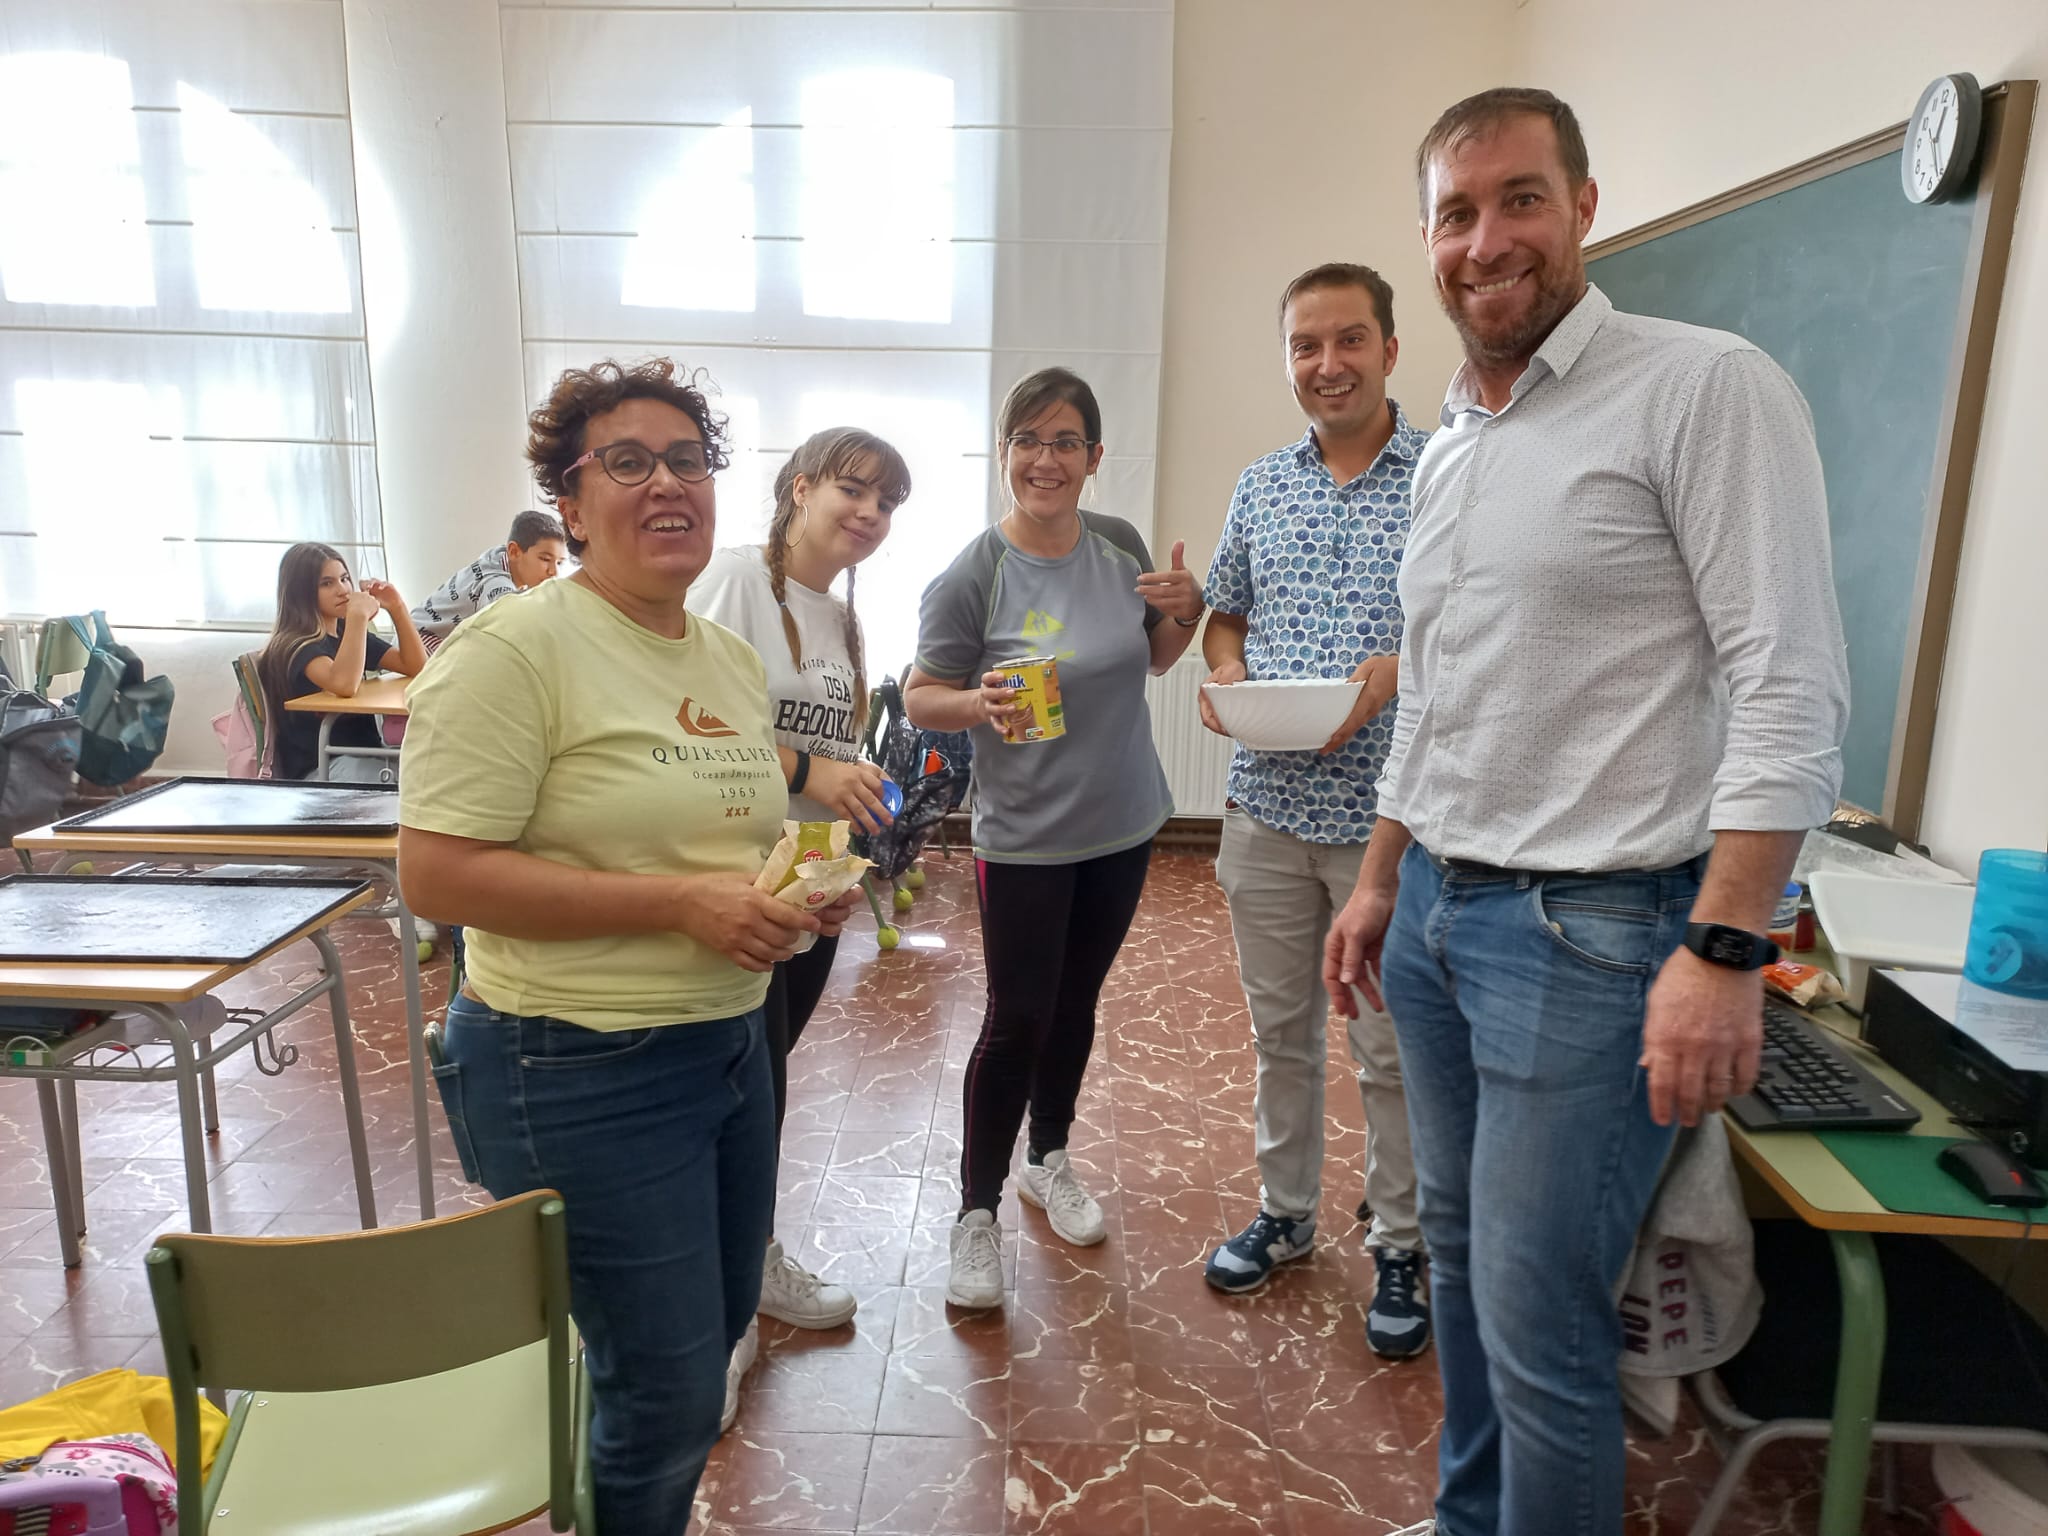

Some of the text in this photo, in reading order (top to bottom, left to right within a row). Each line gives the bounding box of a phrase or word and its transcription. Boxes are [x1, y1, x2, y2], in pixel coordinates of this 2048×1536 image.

[1941, 88, 1949, 104] 12
[1931, 97, 1938, 112] 11
[1922, 117, 1929, 131] 10
[1915, 138, 1921, 152] 9
[1914, 159, 1921, 175] 8
[1919, 172, 1925, 186] 7
[1927, 176, 1933, 191] 6
[797, 658, 826, 675] NITED
[823, 675, 852, 703] USA
[692, 769, 771, 780] Ocean Inspired
[719, 787, 756, 799] 1969
[1656, 1251, 1689, 1350] PEPE
